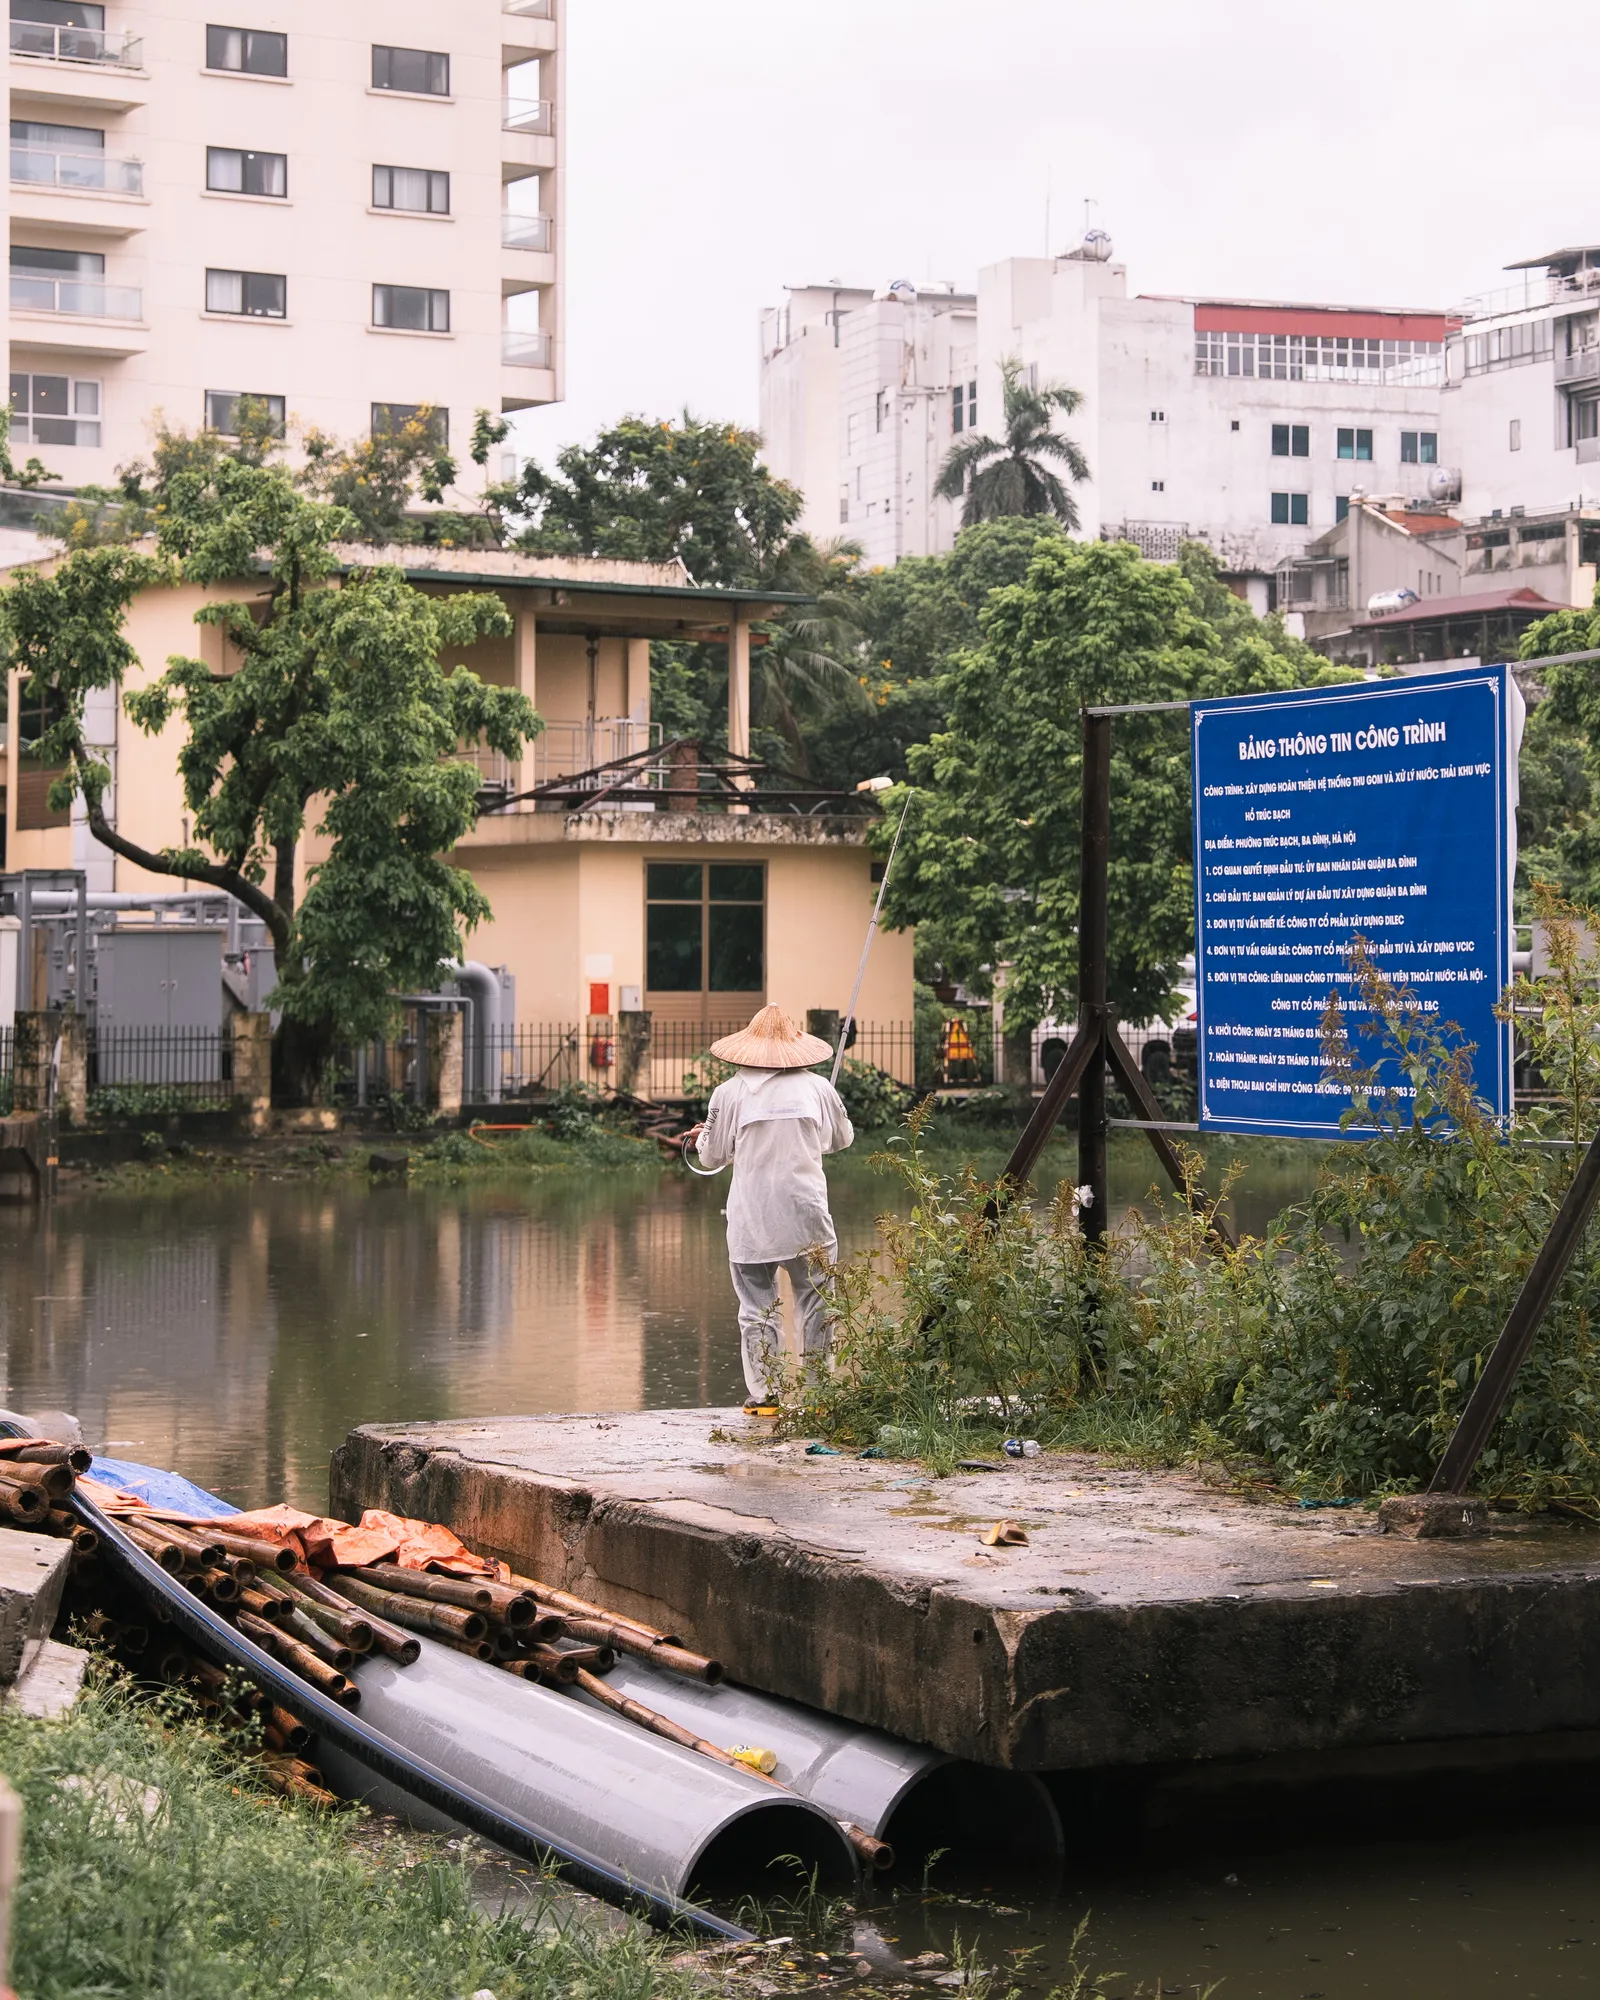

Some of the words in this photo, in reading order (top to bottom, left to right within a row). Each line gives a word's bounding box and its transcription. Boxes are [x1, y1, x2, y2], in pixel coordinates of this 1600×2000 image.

[1239, 735, 1276, 760] BẢNG
[1278, 732, 1327, 757] THÔNG
[1330, 732, 1352, 752] TIN
[1355, 724, 1399, 750] CÔNG
[1402, 718, 1446, 745] TRÌNH
[1204, 785, 1224, 796] CÔNG
[1225, 784, 1244, 796] TRÌNH:
[1245, 782, 1258, 794] XÂY
[1278, 780, 1297, 792] HOÀN
[1352, 776, 1365, 786] THU
[1366, 774, 1383, 785] GOM
[1384, 770, 1394, 784] VÀ
[1406, 768, 1416, 781] LÝ
[1440, 764, 1456, 778] THẢI
[1458, 766, 1473, 776] KHU
[1256, 808, 1272, 820] TRÚC
[1273, 809, 1290, 822] BẠCH
[1205, 840, 1216, 852] ĐỊA
[1263, 834, 1279, 846] TRÚC
[1280, 836, 1300, 848] BẠCH,
[1302, 835, 1312, 846] BA
[1312, 832, 1331, 844] ĐÌNH,
[1332, 831, 1342, 844] HÀ
[1206, 866, 1212, 876] 1.
[1224, 866, 1242, 876] QUAN
[1264, 864, 1278, 876] ĐỊNH
[1316, 862, 1330, 872] BAN
[1331, 858, 1350, 871] NHÂN
[1352, 858, 1366, 870] DÂN
[1387, 858, 1397, 868] BA
[1398, 855, 1417, 868] ĐÌNH
[1206, 893, 1212, 902] 2.
[1252, 892, 1266, 902] BAN
[1267, 888, 1284, 901] QUẢN
[1286, 888, 1294, 900] LÝ
[1306, 888, 1316, 900] ÁN
[1342, 886, 1356, 898] XÂY
[1398, 886, 1408, 896] BA
[1410, 883, 1427, 896] ĐÌNH
[1206, 920, 1212, 928] 3.
[1228, 919, 1236, 931] VỊ
[1287, 916, 1308, 928] CÔNG
[1309, 918, 1317, 928] TY
[1350, 914, 1363, 926] XÂY
[1385, 915, 1404, 926] DILEC
[1206, 946, 1213, 956] 4.
[1230, 946, 1236, 958] VỊ
[1260, 944, 1278, 956] GIÁM
[1278, 944, 1290, 956] SÁT:
[1292, 944, 1312, 956] CÔNG
[1314, 945, 1322, 955] TY
[1404, 940, 1416, 953] VÀ
[1416, 940, 1432, 953] XÂY
[1456, 941, 1474, 952] VCIC
[1208, 972, 1214, 982] 5.
[1230, 972, 1236, 984] VỊ
[1238, 973, 1248, 982] THI
[1248, 971, 1270, 982] CÔNG:
[1271, 971, 1283, 982] LIÊN
[1284, 973, 1304, 982] DANH
[1304, 971, 1326, 982] CÔNG
[1326, 973, 1334, 982] TY
[1334, 973, 1352, 982] TNHH
[1392, 970, 1408, 982] VIÊN
[1410, 969, 1434, 982] THOÁT
[1458, 968, 1468, 981] HÀ
[1272, 998, 1290, 1010] CÔNG
[1292, 1001, 1300, 1010] TY
[1424, 1000, 1439, 1011] E&C
[1208, 1026, 1214, 1036] 6.
[1232, 1024, 1254, 1036] CÔNG:
[1254, 1025, 1273, 1037] NGÀY
[1274, 1028, 1281, 1038] 25
[1282, 1026, 1304, 1038] THÁNG
[1306, 1028, 1314, 1038] 03
[1209, 1052, 1215, 1062] 7.
[1216, 1050, 1234, 1062] HOÀN
[1236, 1052, 1258, 1064] THÀNH:
[1259, 1052, 1276, 1064] NGÀY
[1278, 1055, 1286, 1065] 25
[1286, 1053, 1309, 1066] THÁNG
[1311, 1056, 1318, 1066] 10
[1210, 1079, 1215, 1088] 8.
[1231, 1080, 1250, 1092] THOẠI
[1252, 1082, 1264, 1092] BAN
[1266, 1078, 1276, 1092] CHỈ
[1278, 1083, 1290, 1093] HUY
[1292, 1081, 1312, 1094] CÔNG
